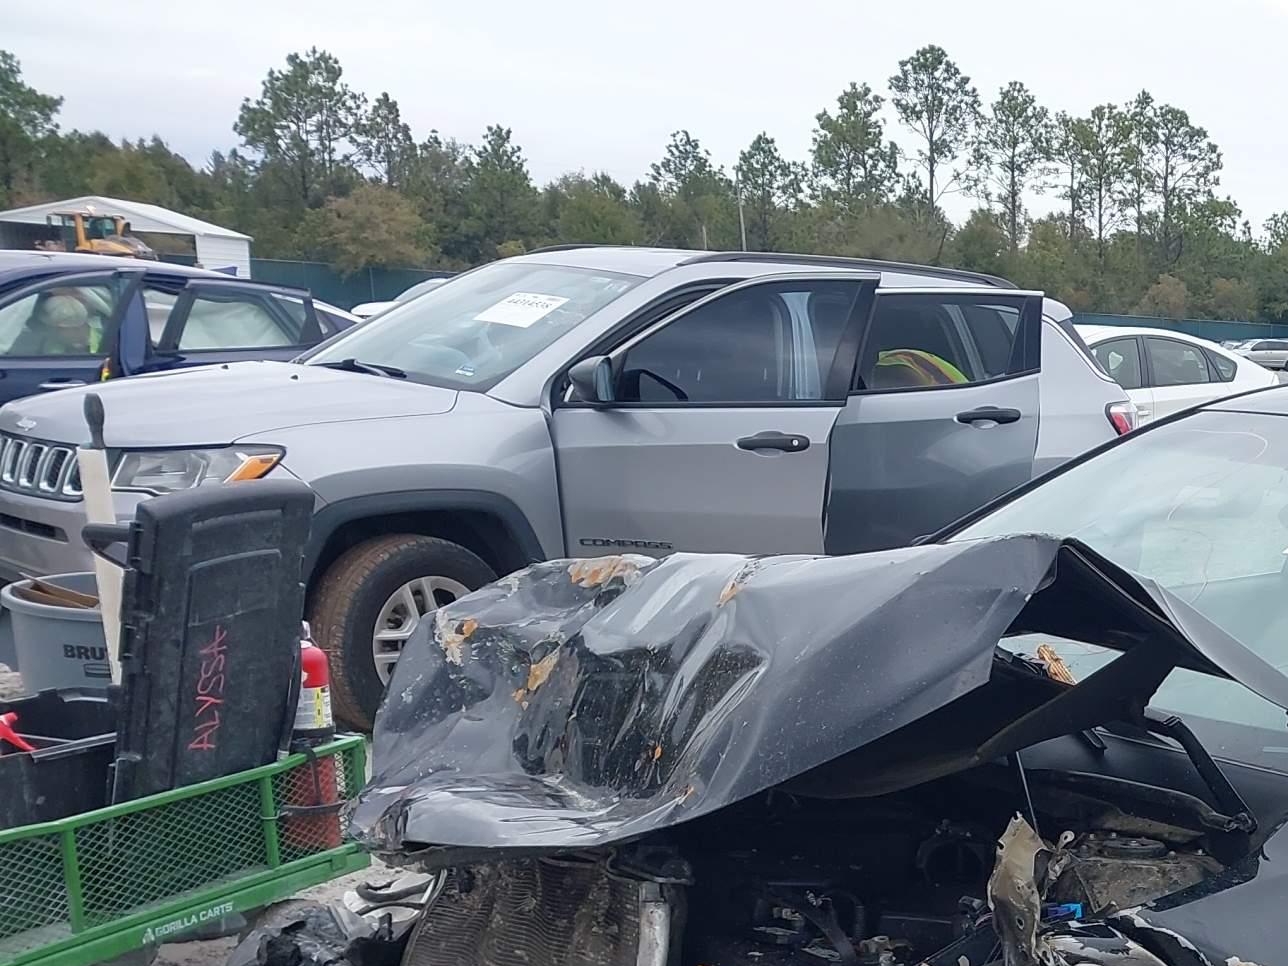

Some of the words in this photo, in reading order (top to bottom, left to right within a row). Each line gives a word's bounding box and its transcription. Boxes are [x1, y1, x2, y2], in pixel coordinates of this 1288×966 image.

[579, 538, 673, 549] COMPASS
[63, 644, 108, 661] BRU
[188, 624, 228, 750] ALYSSA
[154, 914, 198, 937] GORILLA
[199, 901, 235, 921] CARTS
